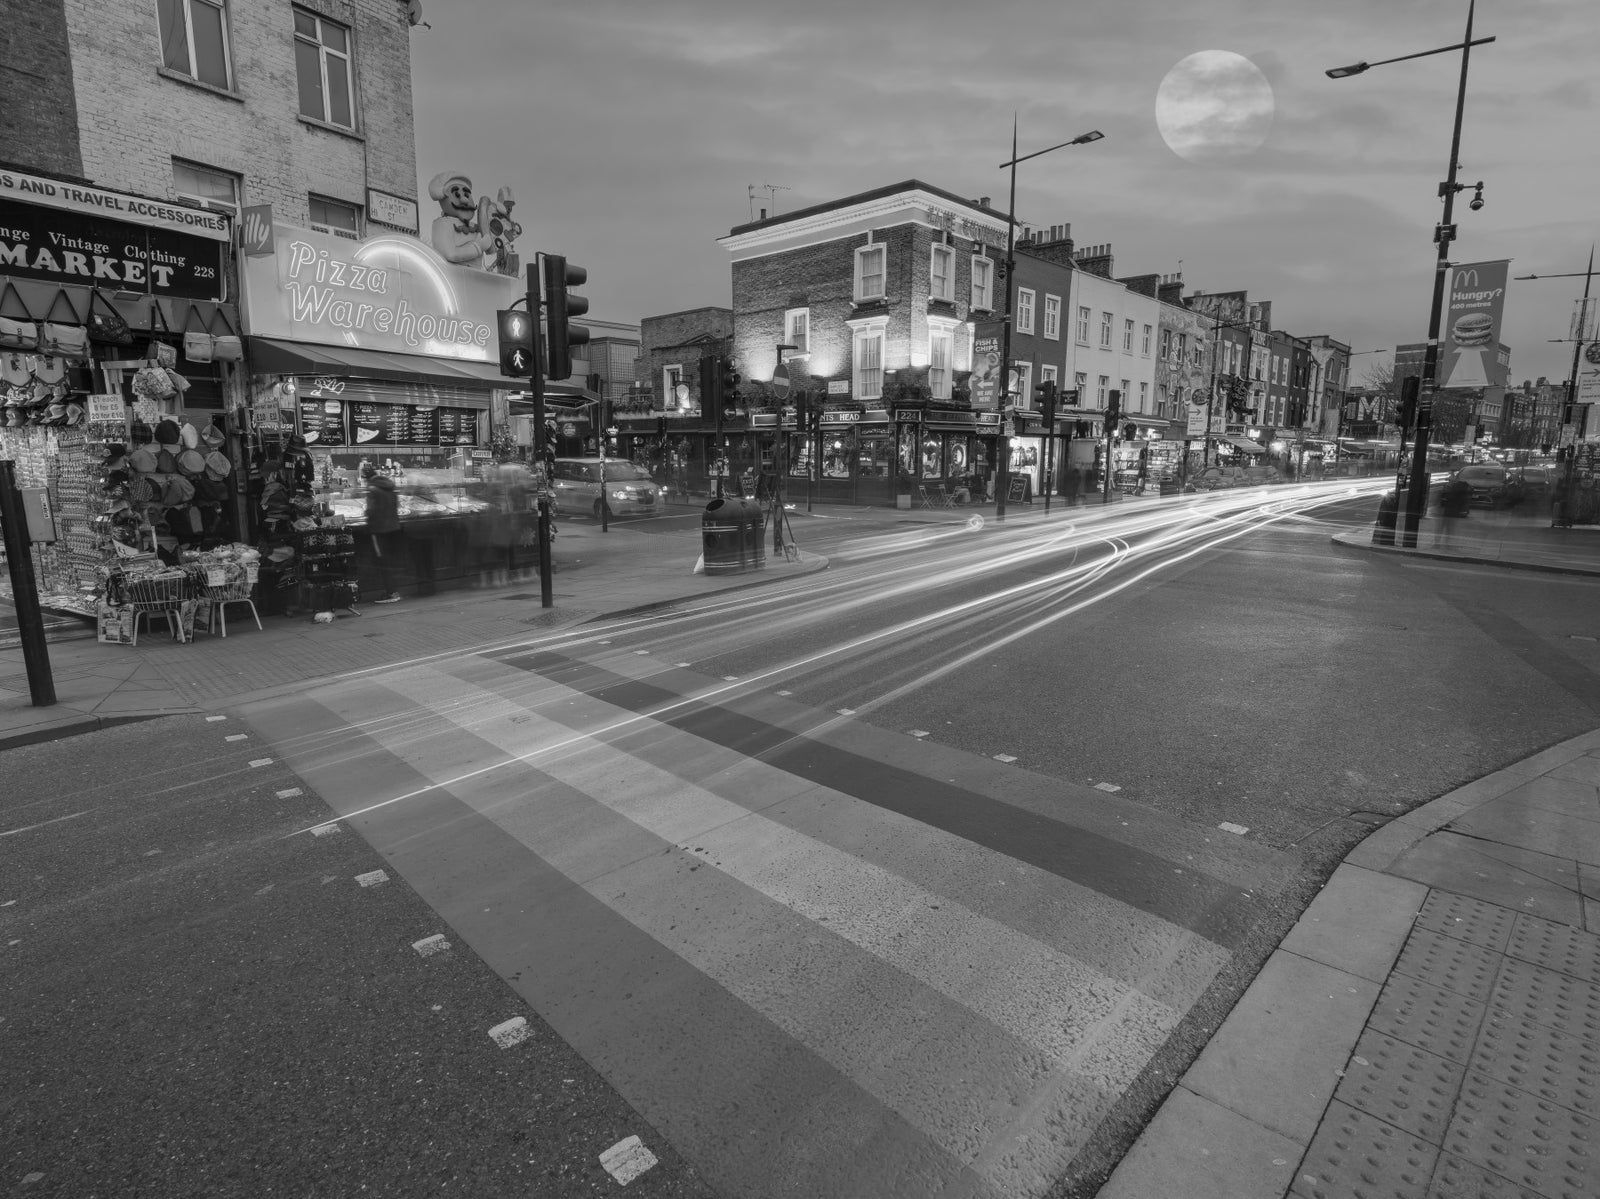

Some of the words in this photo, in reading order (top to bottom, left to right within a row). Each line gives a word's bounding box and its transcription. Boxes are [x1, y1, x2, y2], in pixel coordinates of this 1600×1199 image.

[20, 178, 56, 196] AND
[60, 187, 124, 210] TRAVEL
[128, 201, 226, 231] ACCESSORIES
[48, 231, 110, 254] Vintage
[124, 245, 186, 268] Clothing
[244, 212, 270, 250] illy
[0, 240, 174, 287] MARKET
[193, 265, 215, 279] 228
[289, 240, 388, 294] Pizza
[1452, 288, 1503, 301] Hungry?
[1465, 301, 1492, 309] metres
[285, 282, 492, 346] Warehouse
[839, 413, 860, 421] HEAD
